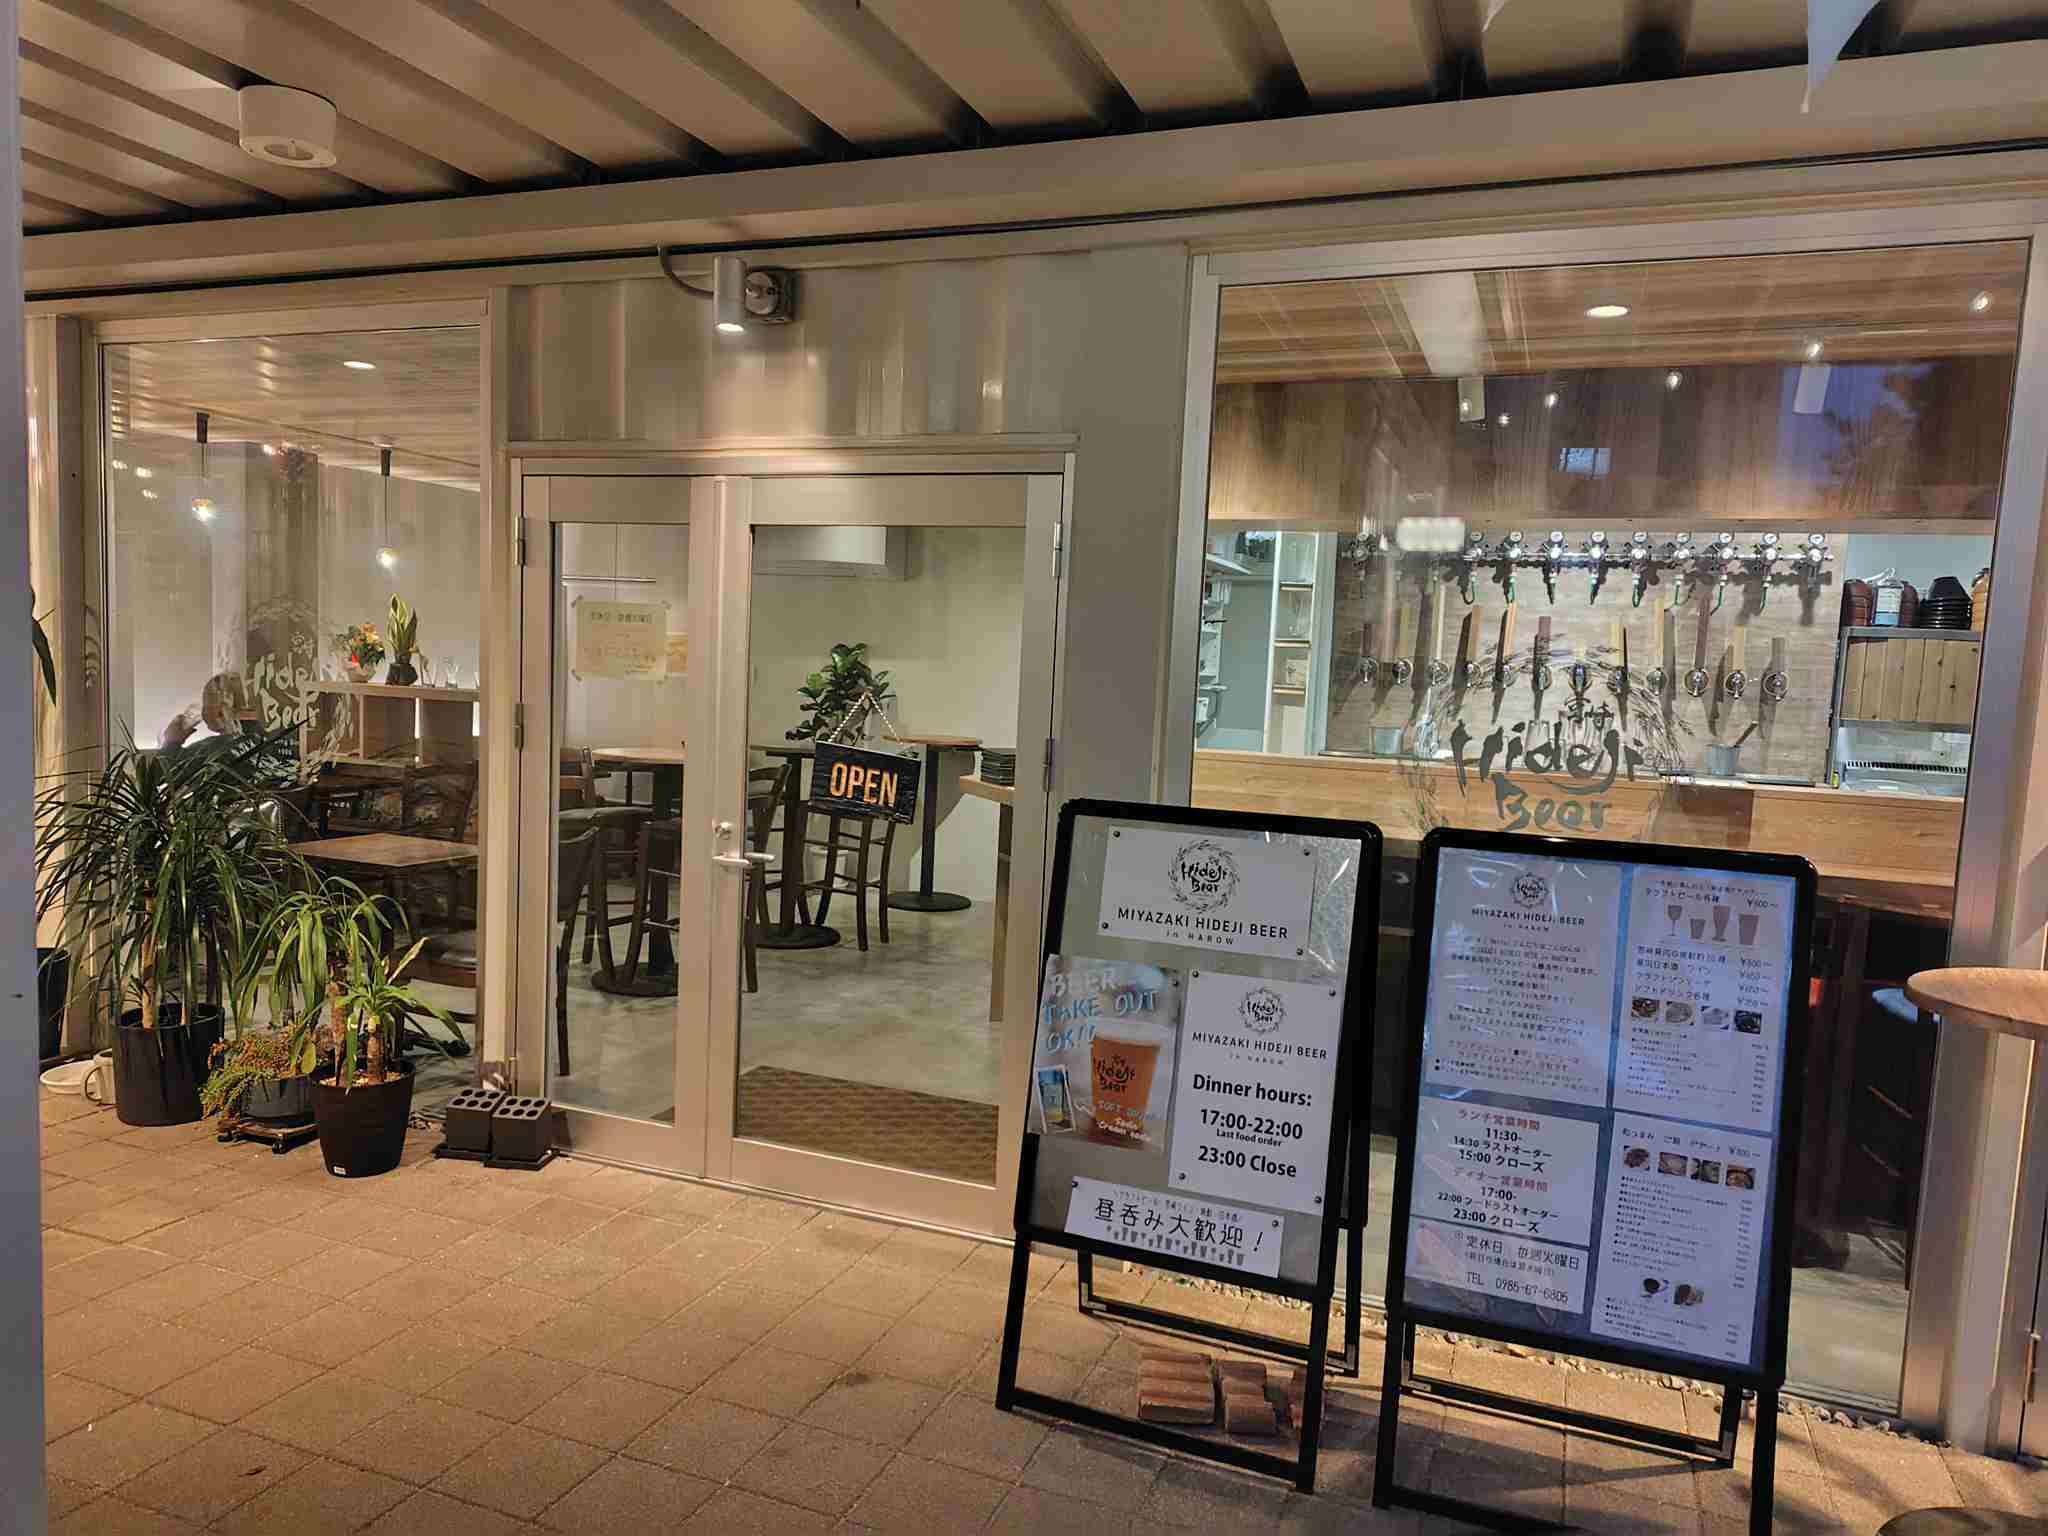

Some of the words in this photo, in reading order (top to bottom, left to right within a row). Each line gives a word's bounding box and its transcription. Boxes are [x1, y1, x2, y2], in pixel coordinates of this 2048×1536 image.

[830, 762, 898, 807] OPEN
[1494, 772, 1611, 832] Beer
[1191, 877, 1220, 893] Beer
[1117, 907, 1189, 927] MIYAZAKI
[1195, 917, 1242, 934] HIDEJI
[1250, 923, 1288, 939] BEER
[1471, 908, 1520, 921] MIYAZAKI
[1559, 915, 1585, 927] BEER
[1192, 1032, 1249, 1049] MIYAZAKI
[1254, 1041, 1292, 1055] HIDEJI
[1297, 1046, 1327, 1060] BEER
[1193, 1074, 1252, 1098] Dinner
[1255, 1083, 1312, 1107] hours:
[1200, 1109, 1303, 1140] 17:00-22:00
[1216, 1128, 1234, 1140] Last
[1235, 1131, 1256, 1143] food
[1257, 1136, 1282, 1148] order
[1454, 1136, 1480, 1148] 14:30
[1483, 1141, 1553, 1158] ラストオーダー
[1198, 1145, 1246, 1168] 23:00
[1249, 1155, 1297, 1178] Close
[1459, 1149, 1491, 1164] 15:00
[1495, 1155, 1545, 1174] クローズ
[1437, 1191, 1463, 1204] 22:00
[1453, 1208, 1487, 1224] 23:00
[1490, 1215, 1540, 1234] クローズ
[1466, 1235, 1503, 1254] 定休日
[1518, 1246, 1580, 1271] 毎週火曜日
[1465, 1271, 1485, 1287] TEL
